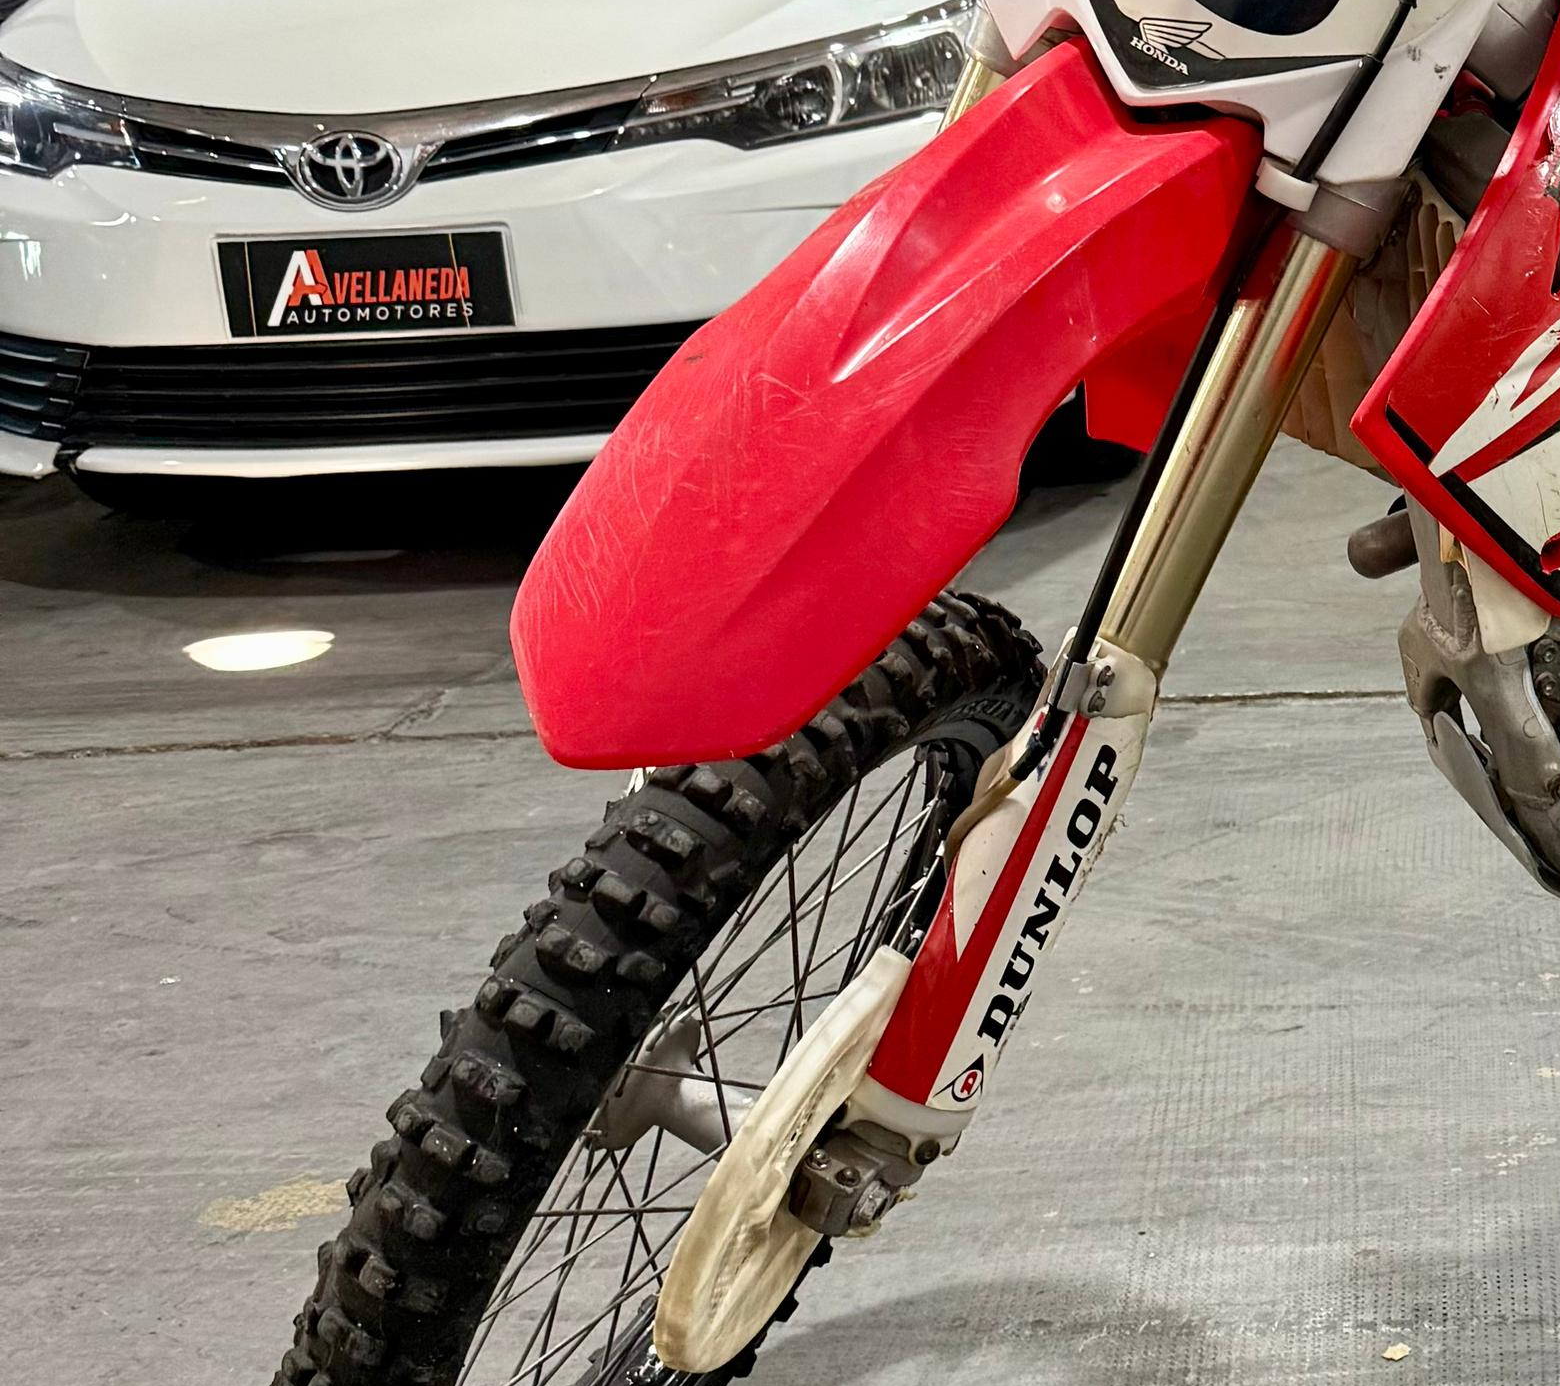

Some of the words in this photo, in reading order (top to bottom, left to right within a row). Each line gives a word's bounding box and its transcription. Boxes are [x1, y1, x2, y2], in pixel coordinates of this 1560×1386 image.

[1130, 36, 1190, 76] HONDA
[267, 249, 471, 327] AVELLANEDA
[286, 302, 474, 326] AUTOMOTORES
[976, 743, 1119, 1048] DUNLOP
